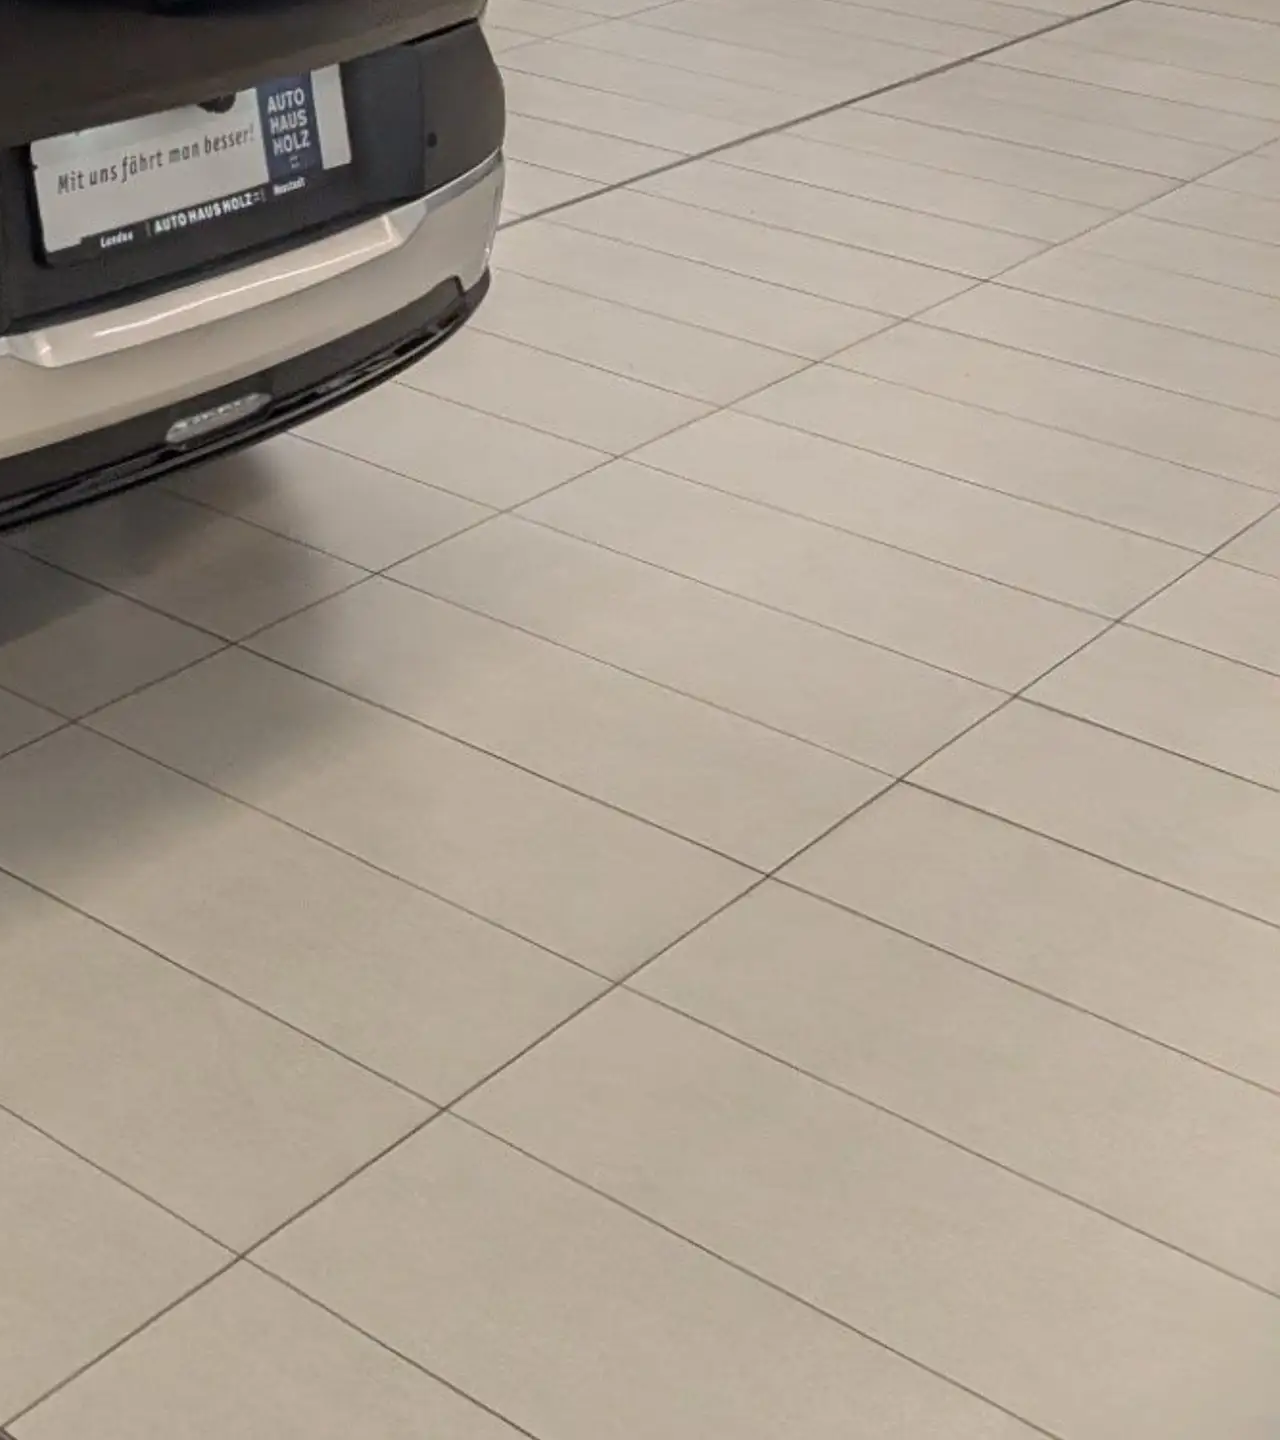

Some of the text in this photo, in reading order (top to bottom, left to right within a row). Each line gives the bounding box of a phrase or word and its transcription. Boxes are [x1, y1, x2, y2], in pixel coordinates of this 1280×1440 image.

[267, 87, 305, 114] AUTO
[269, 108, 308, 135] HAUS
[272, 129, 311, 157] HOLZ
[57, 124, 255, 195] Mit uns fährt man besser!
[154, 212, 187, 234] AUTO
[189, 203, 221, 223] HAUS
[222, 192, 252, 213] HOLZ
